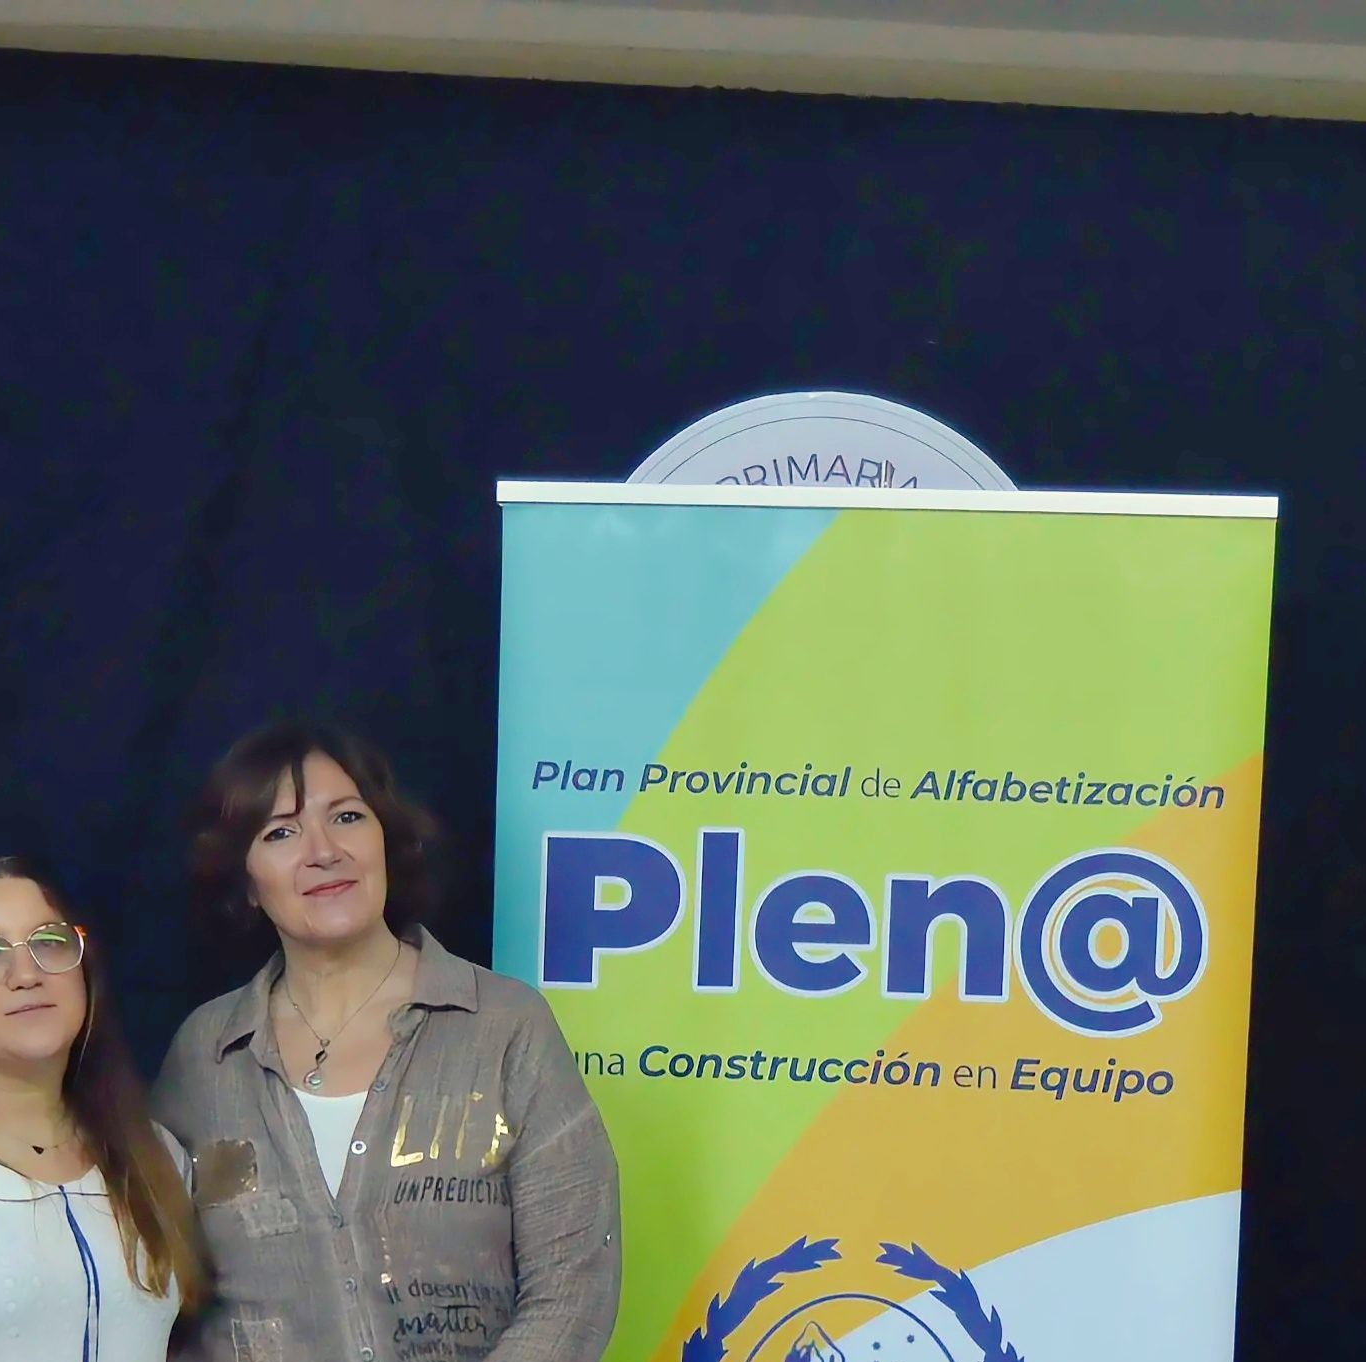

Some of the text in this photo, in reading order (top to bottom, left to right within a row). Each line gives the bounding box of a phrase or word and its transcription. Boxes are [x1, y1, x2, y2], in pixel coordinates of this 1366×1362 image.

[532, 760, 1226, 810] Plan Provincial de Alfabetización
[539, 827, 1209, 1037] Plen@
[638, 1044, 942, 1088] Construcción
[953, 1062, 998, 1091] en
[1009, 1058, 1176, 1104] Equipo
